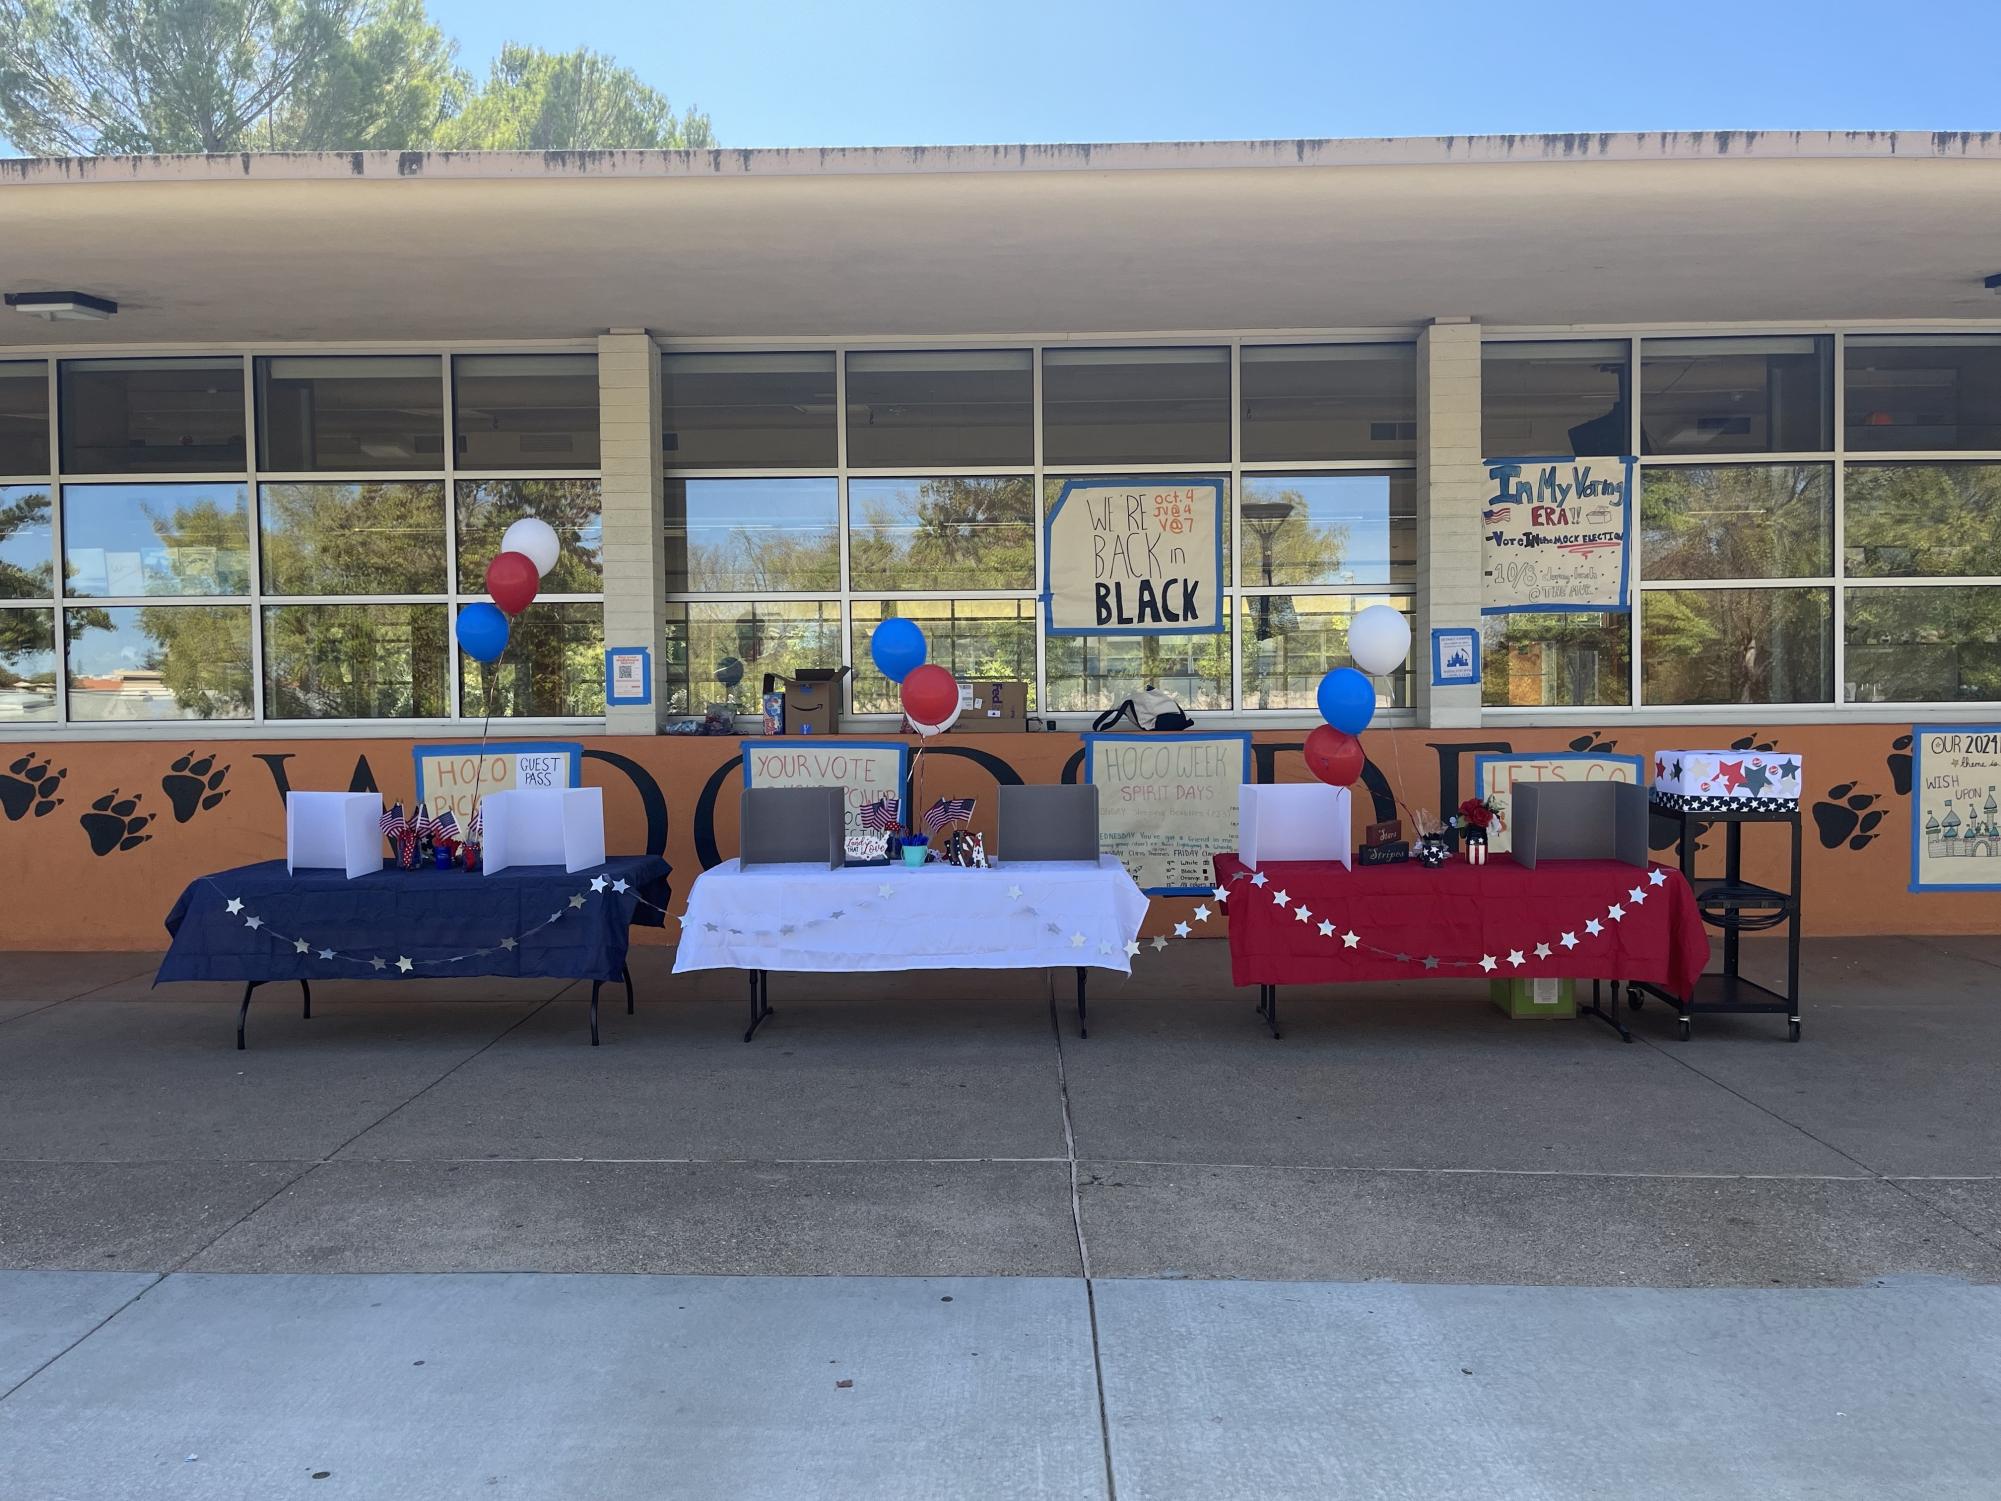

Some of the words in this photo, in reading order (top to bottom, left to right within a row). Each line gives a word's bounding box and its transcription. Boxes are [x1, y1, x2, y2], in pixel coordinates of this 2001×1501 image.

[1488, 464, 1533, 506] In
[1538, 466, 1573, 508] My
[1185, 488, 1195, 502] 4
[1553, 534, 1579, 545] MOCK
[1093, 532, 1162, 579] BACK
[1170, 547, 1186, 564] in
[1095, 578, 1200, 626] BLACK
[1931, 735, 1962, 755] OUR
[1965, 735, 1998, 755] 2024
[520, 757, 561, 773] GUEST
[757, 755, 812, 780] YOUR
[814, 754, 877, 782] VOTE
[1105, 745, 1170, 782] HOCO
[1176, 744, 1229, 779] WEEK
[1961, 756, 1987, 768] theme
[437, 756, 508, 788] HOCO
[525, 772, 552, 787] PASS
[1926, 774, 1960, 790] WISH
[1120, 784, 1168, 802] SPIRIT
[1176, 784, 1215, 801] DAYS
[1955, 787, 1982, 801] UPON
[1099, 832, 1135, 841] EDNESDAY
[1173, 848, 1200, 858] FRIDAY
